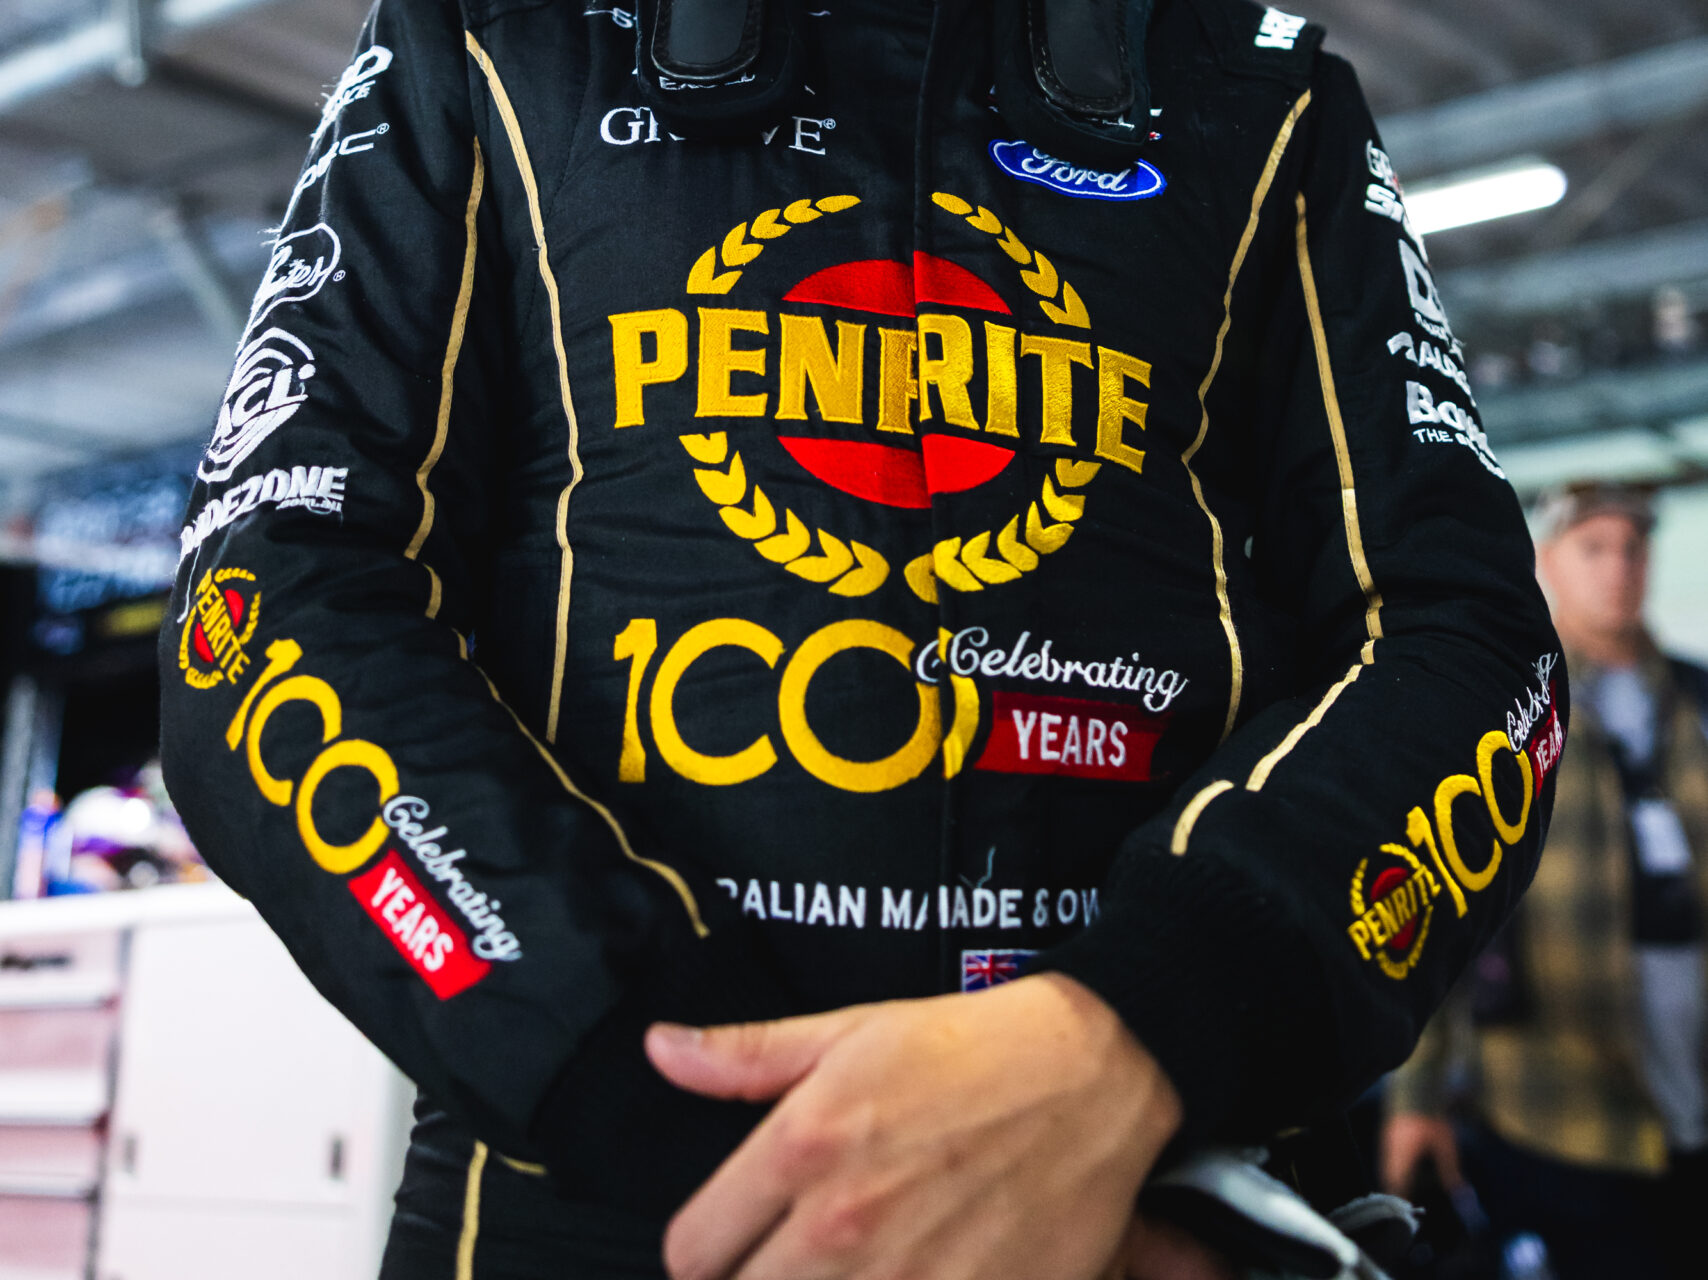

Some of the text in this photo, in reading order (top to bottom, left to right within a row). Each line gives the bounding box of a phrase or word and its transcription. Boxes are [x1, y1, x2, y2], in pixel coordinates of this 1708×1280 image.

[1021, 148, 1132, 192] Ford
[608, 306, 1153, 475] PENRITE
[1413, 428, 1453, 443] THE
[196, 567, 251, 686] PENRITE
[950, 626, 1189, 712] Celebrating
[226, 638, 399, 874] 100
[1012, 709, 1129, 767] YEARS
[1406, 730, 1533, 919] 100
[371, 867, 454, 972] YEARS
[383, 795, 523, 962] Celebrating
[1033, 888, 1048, 927] &
